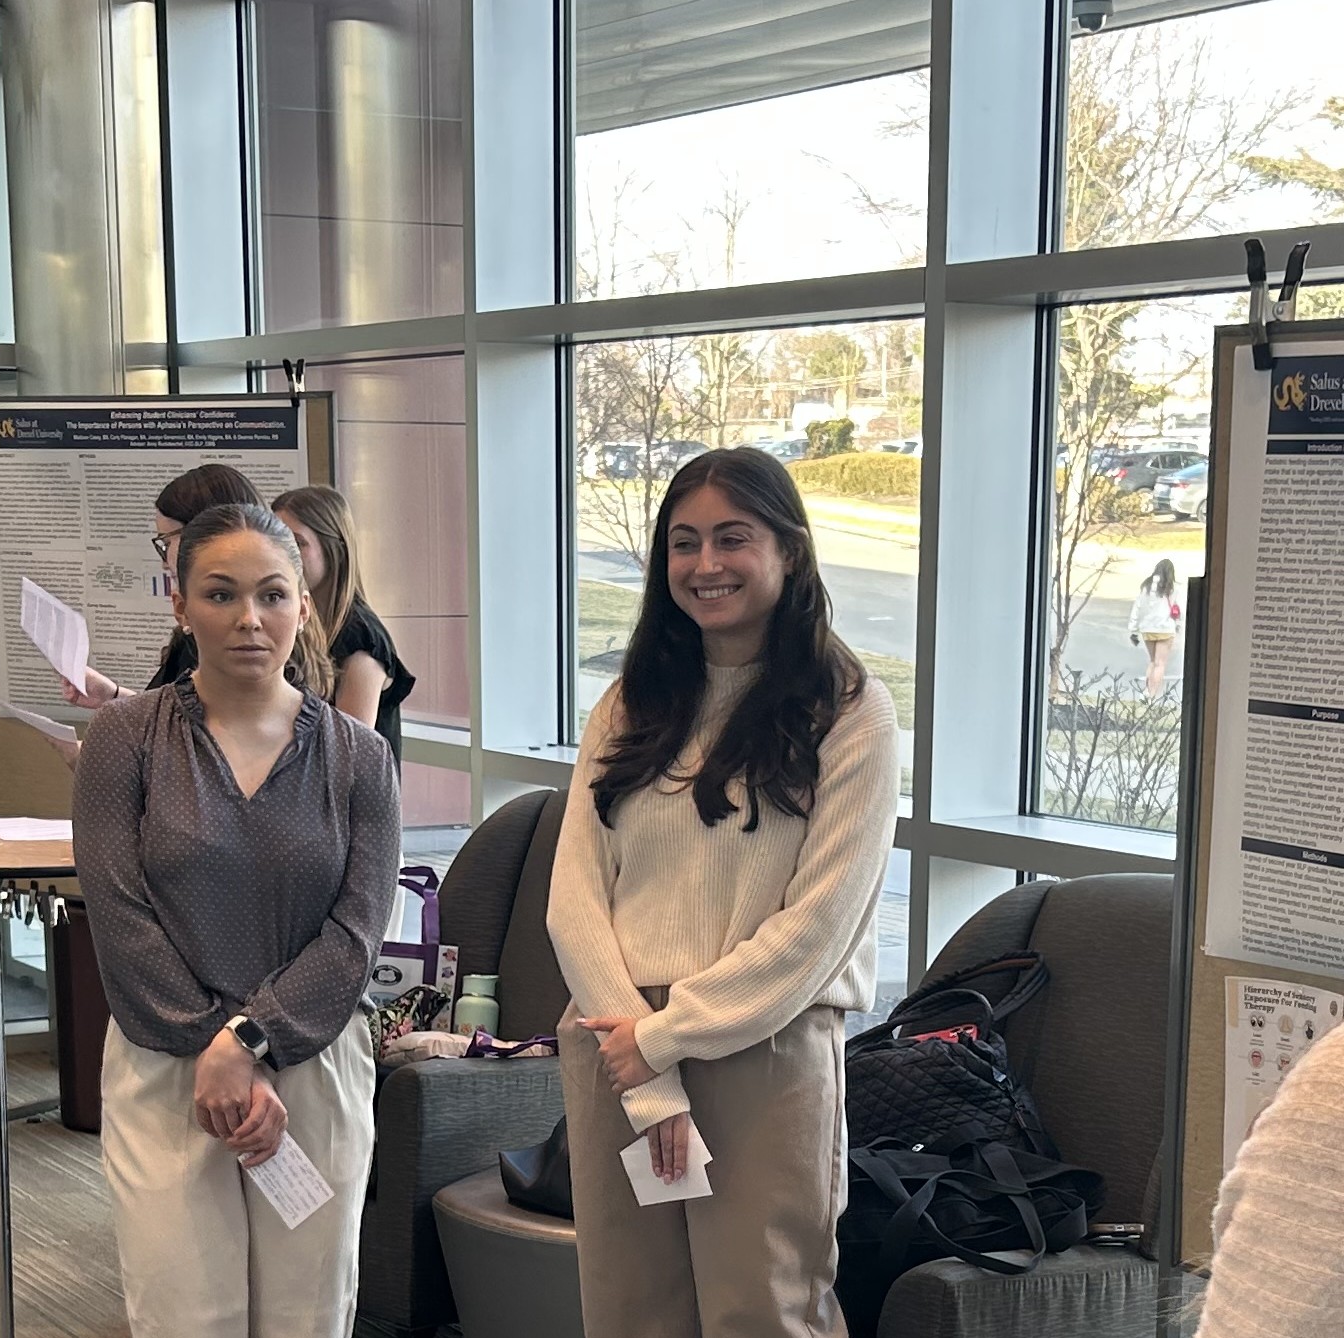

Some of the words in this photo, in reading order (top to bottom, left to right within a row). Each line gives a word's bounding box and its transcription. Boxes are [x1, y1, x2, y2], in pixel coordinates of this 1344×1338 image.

[1310, 373, 1340, 390] Salus
[1310, 394, 1344, 411] Drexel
[1312, 711, 1339, 720] Purpose
[1303, 851, 1327, 862] Methods
[1244, 986, 1282, 998] Hierarchy
